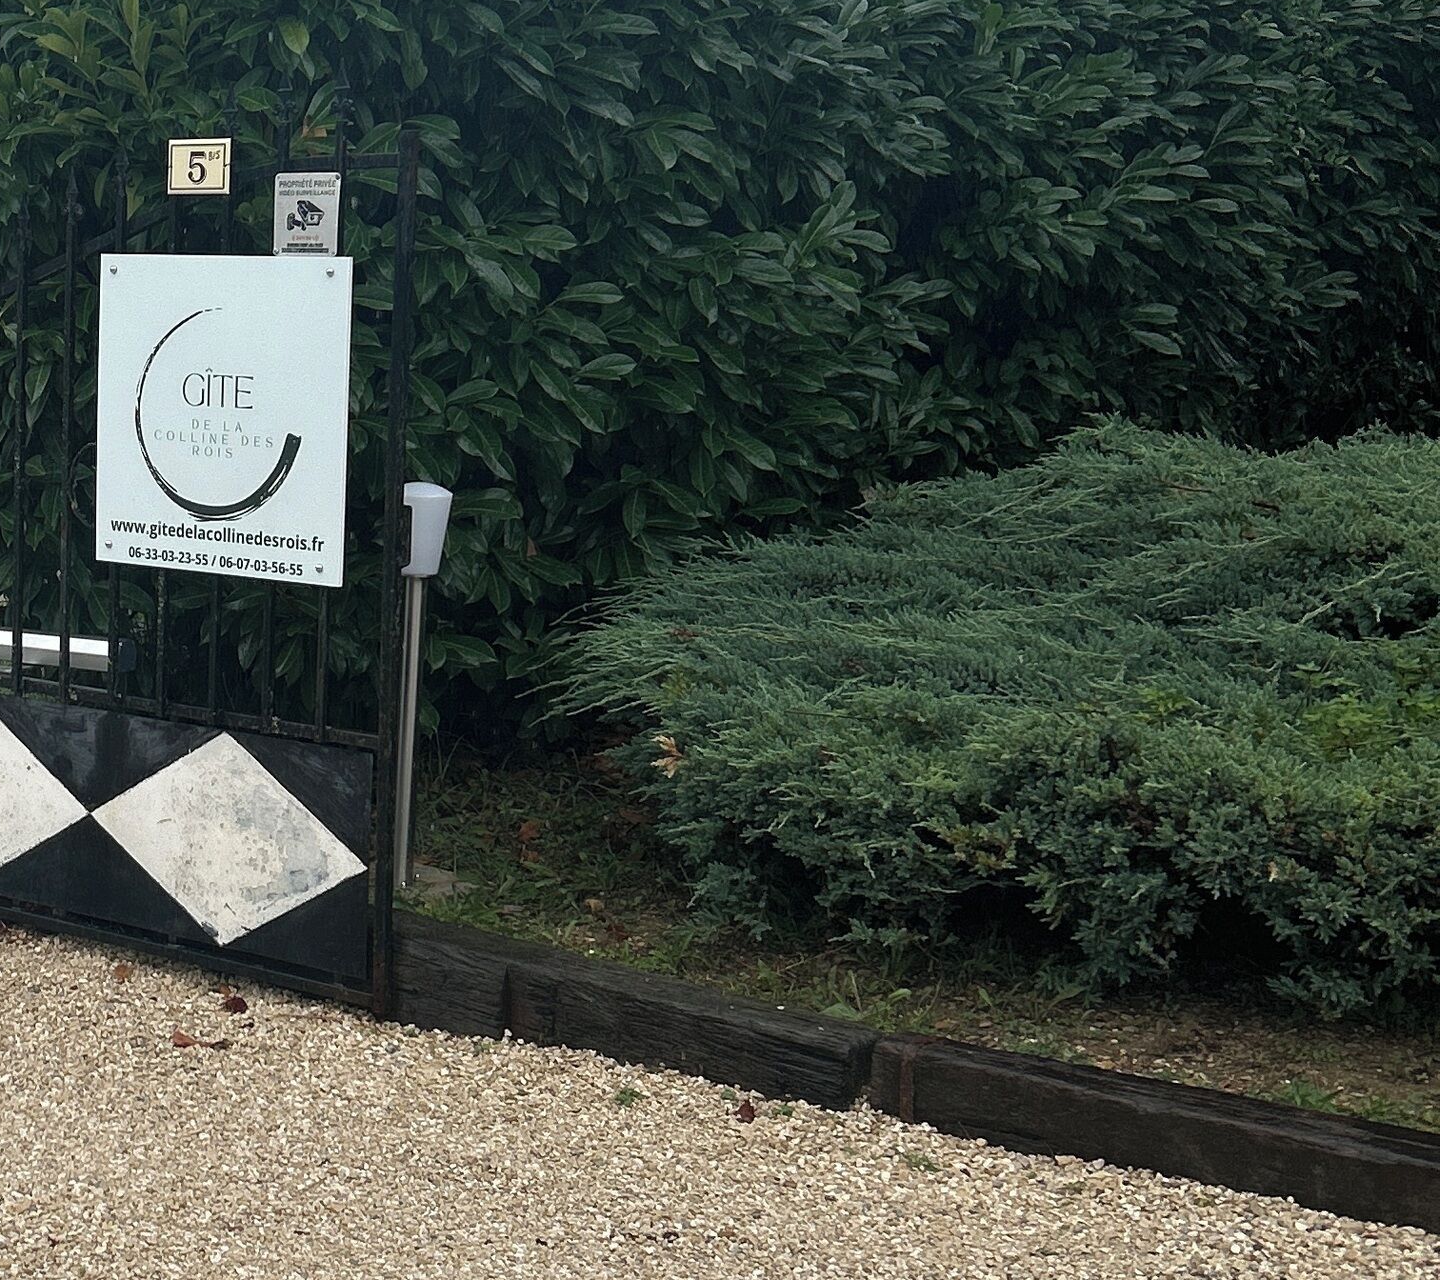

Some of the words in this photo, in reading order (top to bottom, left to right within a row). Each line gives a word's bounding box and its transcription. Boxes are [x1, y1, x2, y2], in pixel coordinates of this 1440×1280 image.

[188, 151, 207, 185] 5
[182, 367, 254, 409] GÎTE
[154, 429, 229, 445] COLLINE
[241, 435, 274, 448] DES
[191, 419, 211, 430] DE
[223, 421, 243, 432] LA
[192, 445, 233, 459] ROIS
[111, 520, 324, 552] www.gitedelacollinedesrois.fr
[128, 546, 208, 566] 06-33-03-23-55
[219, 556, 303, 576] 06-07-03-56-55
